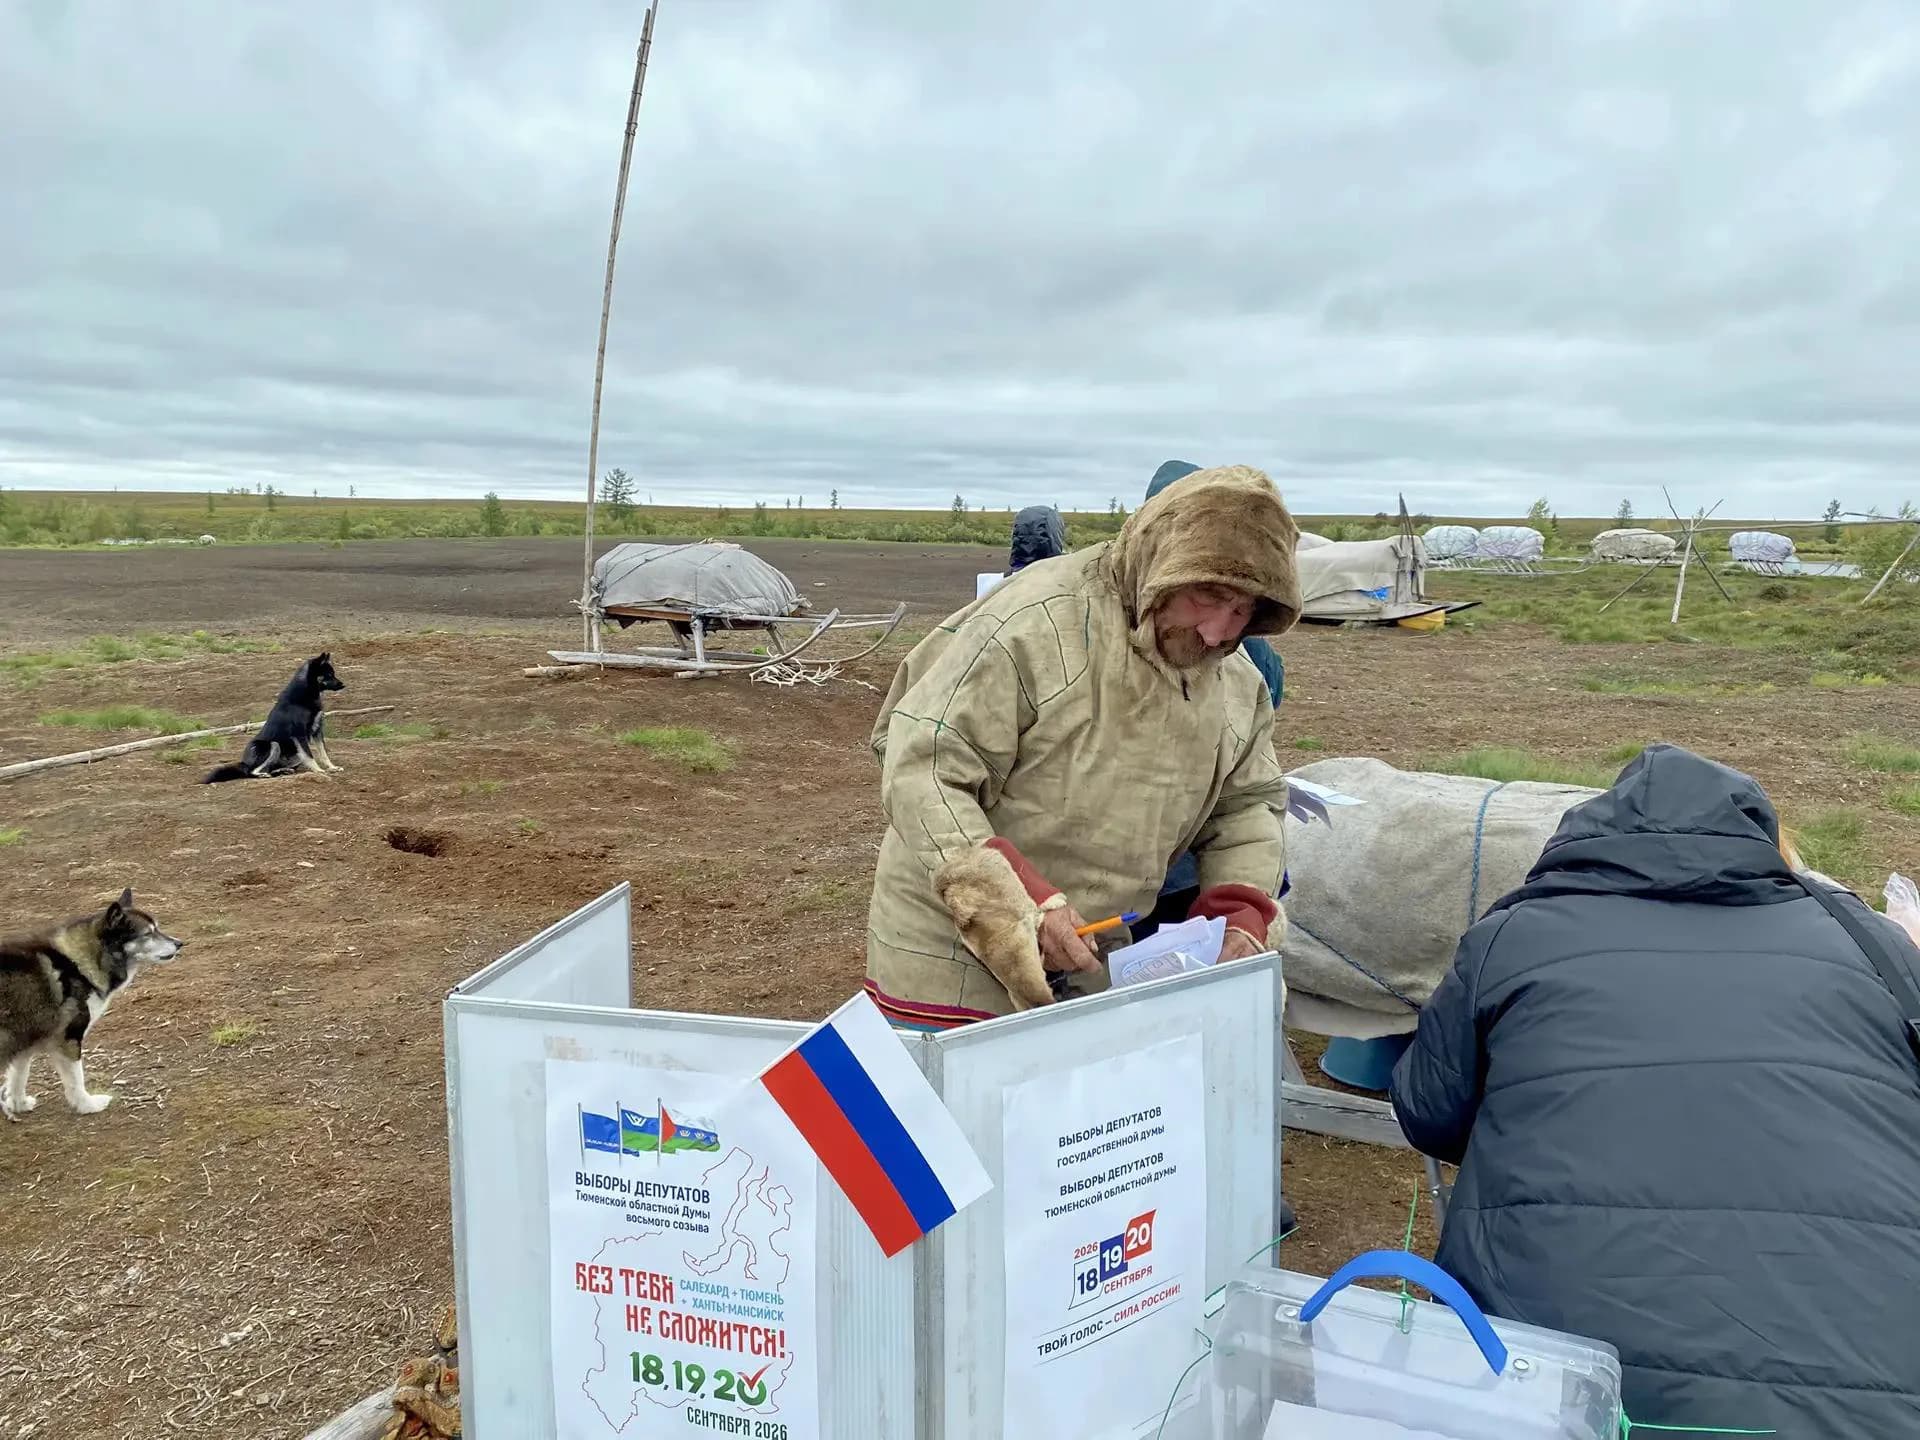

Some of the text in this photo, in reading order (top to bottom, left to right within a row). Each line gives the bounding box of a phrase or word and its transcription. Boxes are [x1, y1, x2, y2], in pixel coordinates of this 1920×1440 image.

[1059, 1106, 1162, 1148] ВЫБОРЫ ДЕПУТАТОВ
[1057, 1125, 1165, 1168] ГОСУДАРСТВЕННОЙ ДУМЫ
[575, 1171, 710, 1204] ВЫБОРЫ ДЕПУТАТОВ
[1045, 1165, 1177, 1219] ТЮМЕНСКОЙ ОБЛАСТНОЙ ДУМЫ
[1060, 1152, 1164, 1196] ВЫБОРЫ ДЕПУТАТОВ
[576, 1190, 710, 1220] Тюменской областной Думы
[626, 1214, 709, 1234] восьмого созыва
[1074, 1241, 1098, 1259] 2026
[1077, 1222, 1151, 1295] 18 19 20
[576, 1262, 674, 1304] БЕЗ ТЕБЯ
[680, 1279, 729, 1299] САЛЕХАРД
[740, 1288, 784, 1305] ТЮМЕНЬ
[1104, 1265, 1153, 1295] СЕНТЯБРЯ
[692, 1297, 784, 1322] ХАНТЫ-МАНСИЙСК
[1037, 1333, 1067, 1356] ТВОЙ
[1070, 1320, 1103, 1344] ГОЛОС
[1114, 1303, 1139, 1323] СИЛА
[1141, 1284, 1181, 1312] РОССИИ!
[626, 1304, 785, 1358] НЕ СЛОЖИТСЯ!
[687, 1406, 788, 1440] СЕНТЯБРЯ 2026
